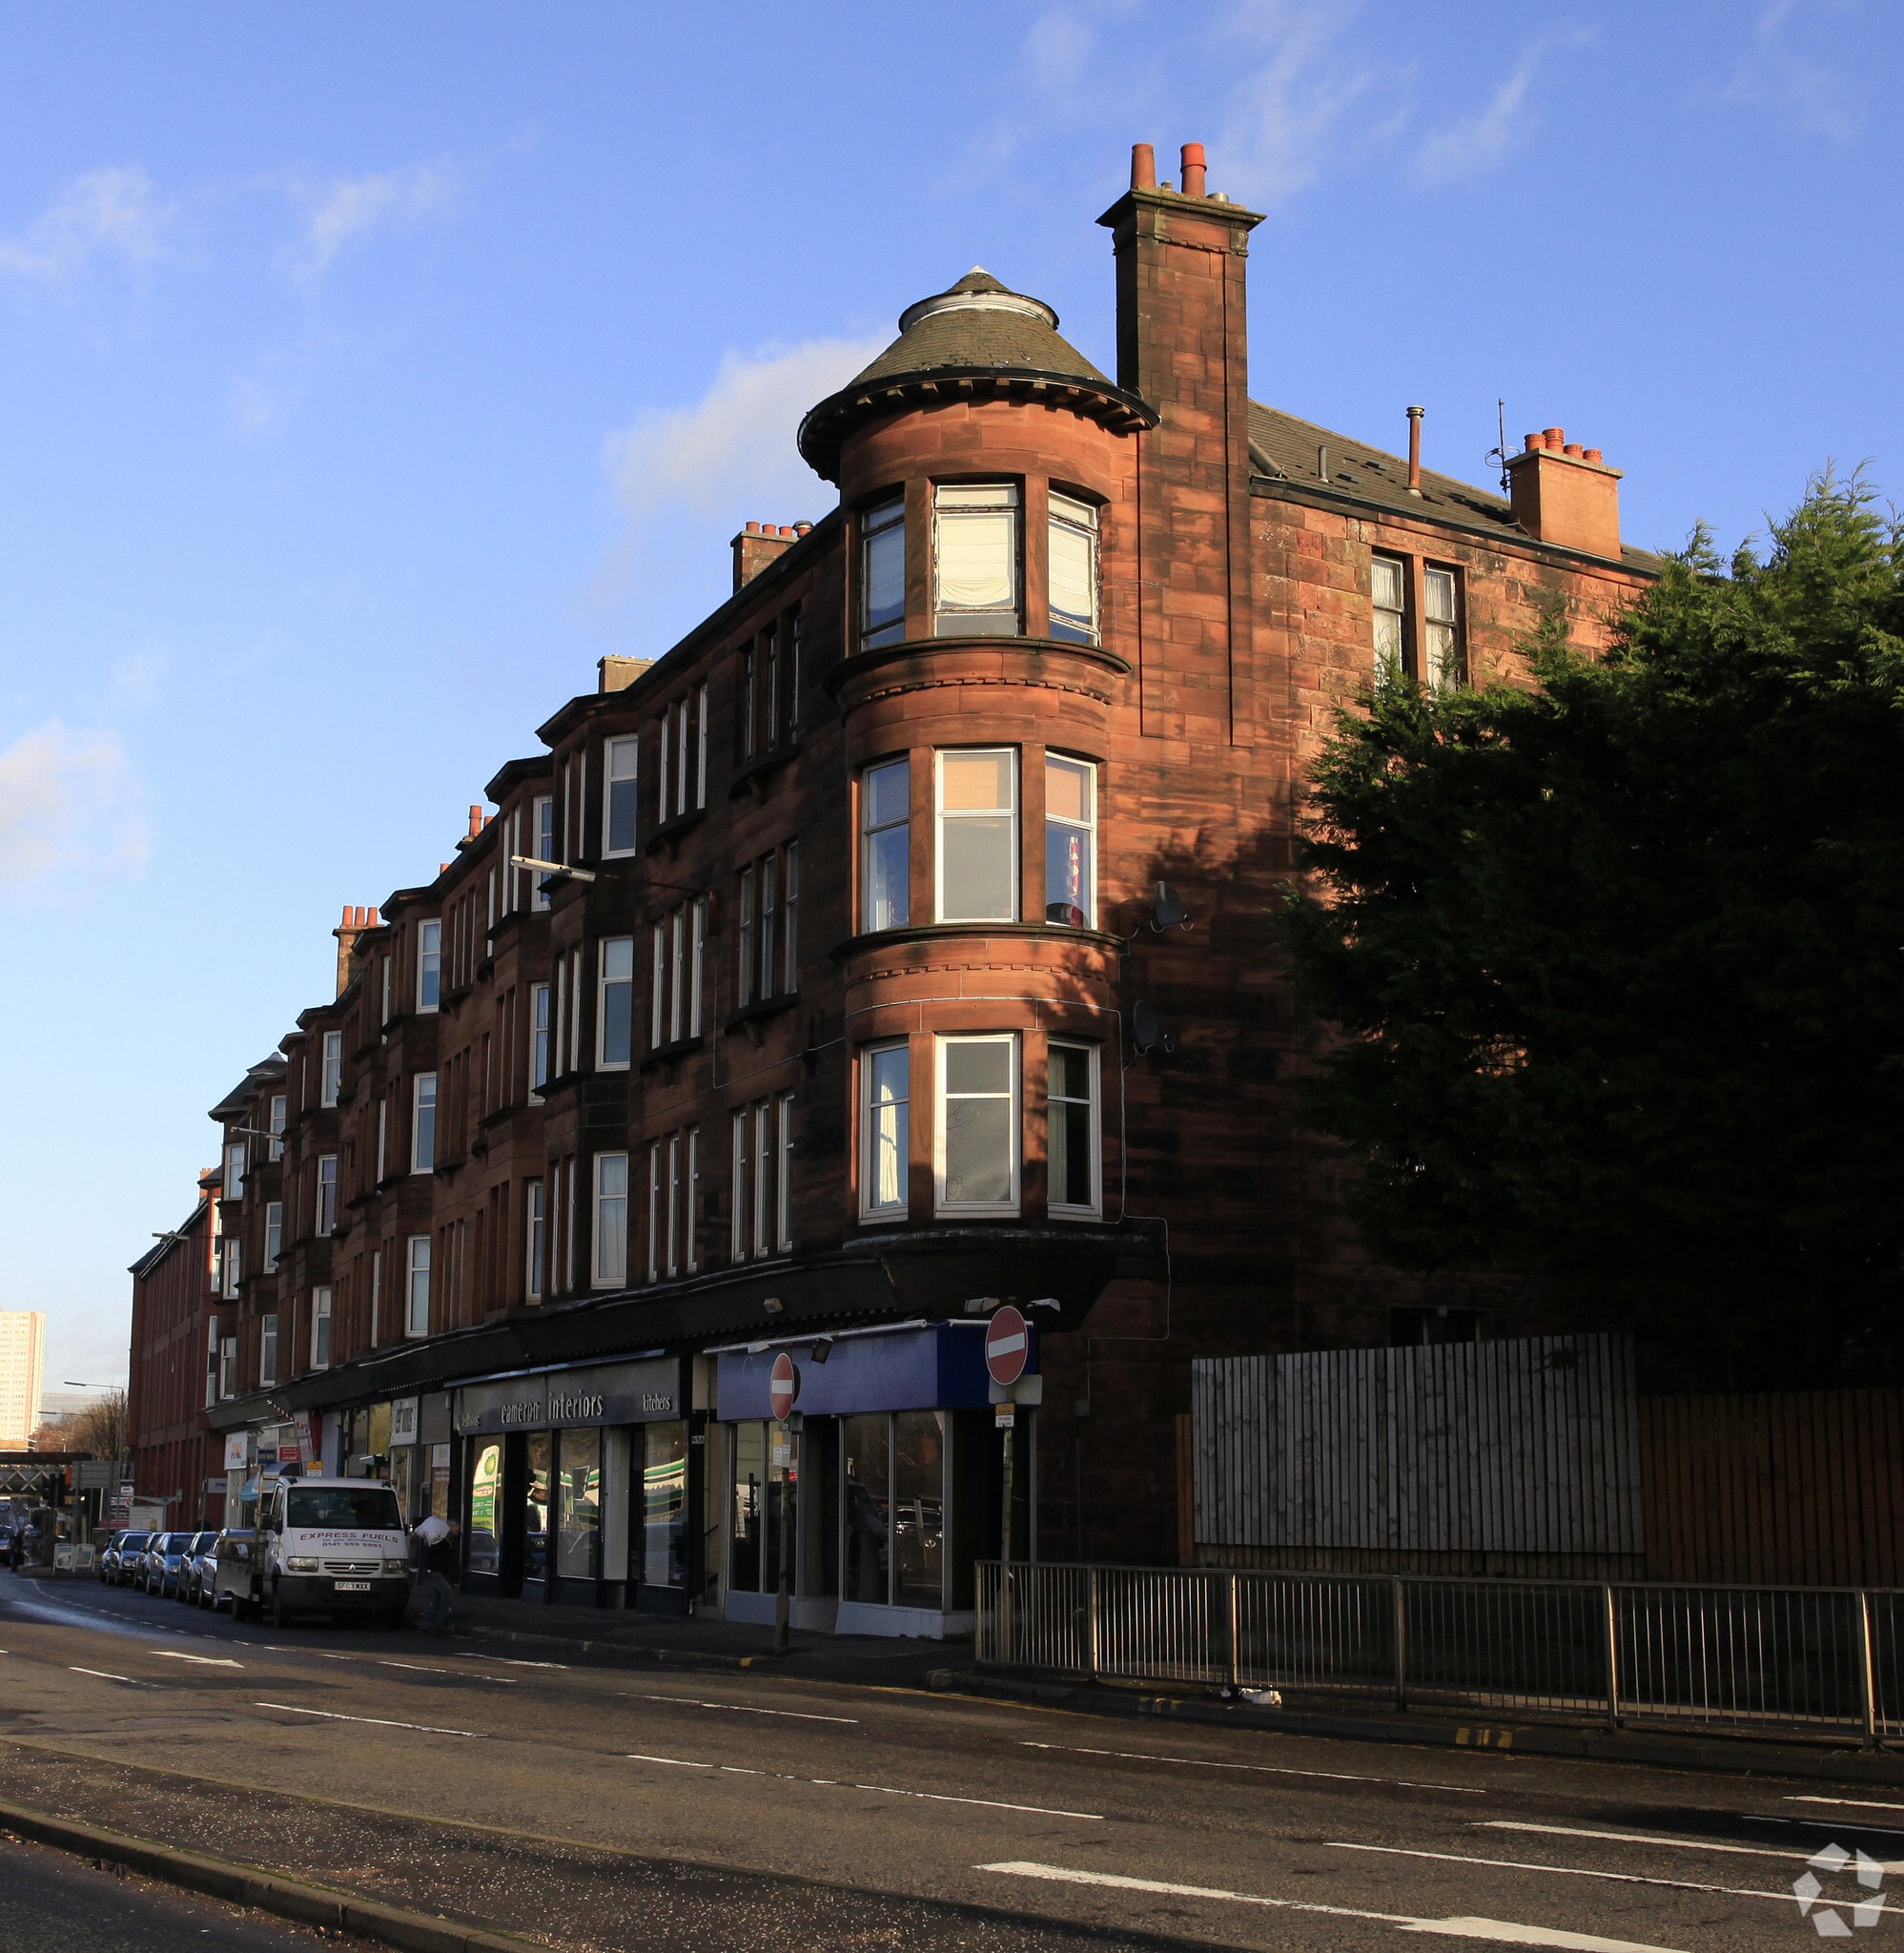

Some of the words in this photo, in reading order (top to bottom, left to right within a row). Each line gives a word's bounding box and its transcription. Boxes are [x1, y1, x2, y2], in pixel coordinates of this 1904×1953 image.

[501, 1402, 540, 1424] cameron
[548, 1388, 604, 1420] interiors
[643, 1393, 671, 1412] kitchens
[299, 1532, 357, 1541] EXPRESS
[362, 1532, 399, 1544] FUELS
